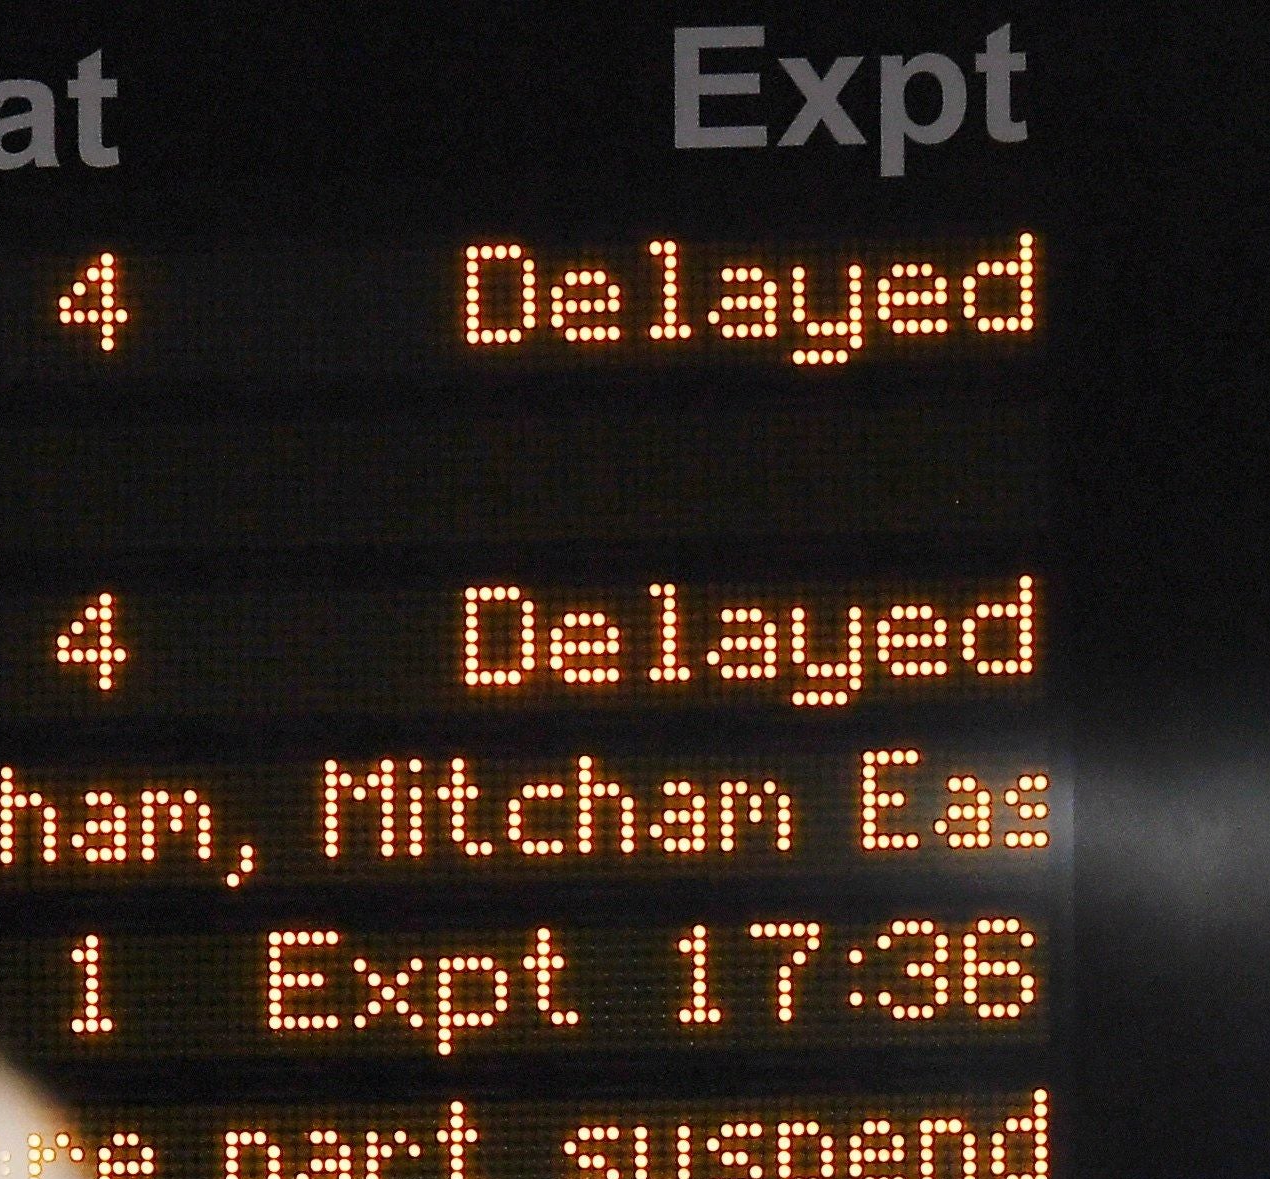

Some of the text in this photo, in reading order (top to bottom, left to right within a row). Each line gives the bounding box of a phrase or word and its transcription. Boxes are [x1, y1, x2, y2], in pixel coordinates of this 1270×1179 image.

[672, 23, 1030, 177] Expt
[58, 252, 129, 352] 4
[464, 232, 1036, 366] Delayed
[57, 592, 128, 692] 4
[464, 575, 1035, 707] Delayed
[324, 755, 793, 860] Mitcham
[71, 934, 115, 1034] 1
[268, 927, 581, 1058] Expt
[678, 918, 1037, 1024] 17:36
